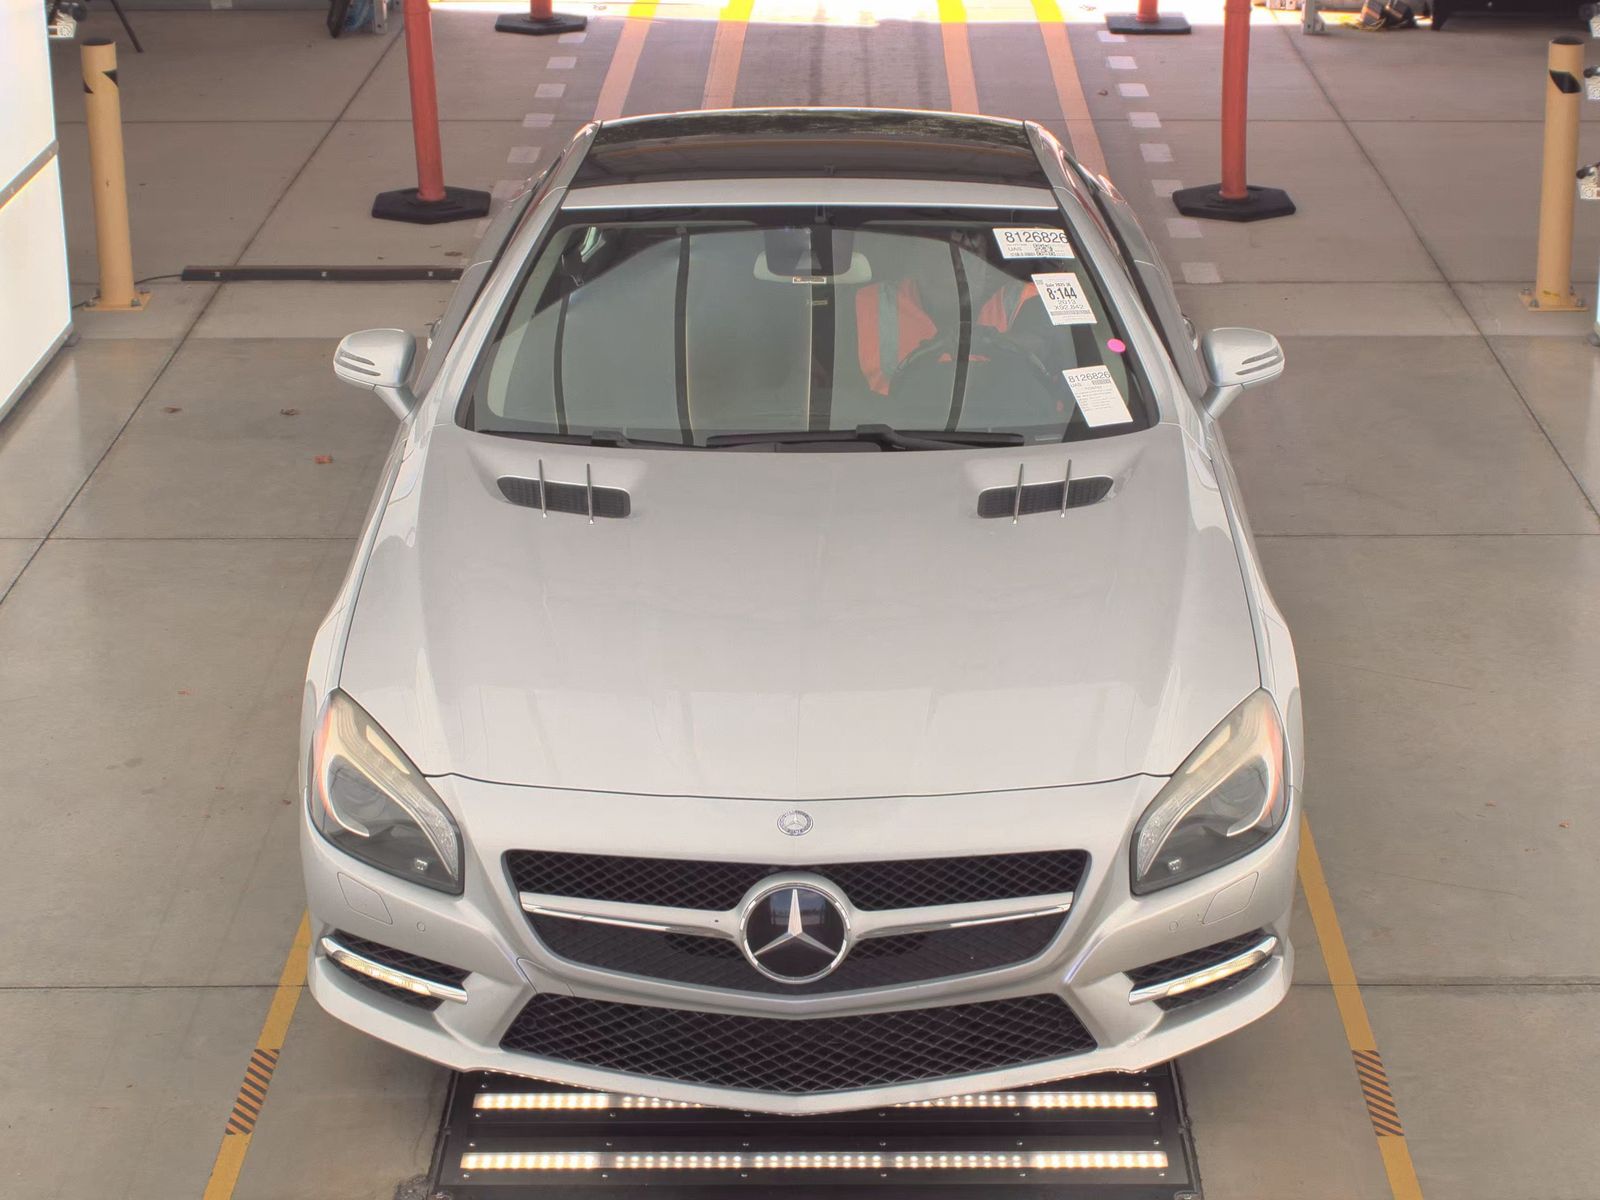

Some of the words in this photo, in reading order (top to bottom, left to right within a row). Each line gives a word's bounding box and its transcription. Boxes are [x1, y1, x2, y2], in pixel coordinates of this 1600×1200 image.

[1004, 231, 1069, 244] 8126826
[1046, 287, 1078, 300] 8:144
[1068, 371, 1111, 383] 8126826
